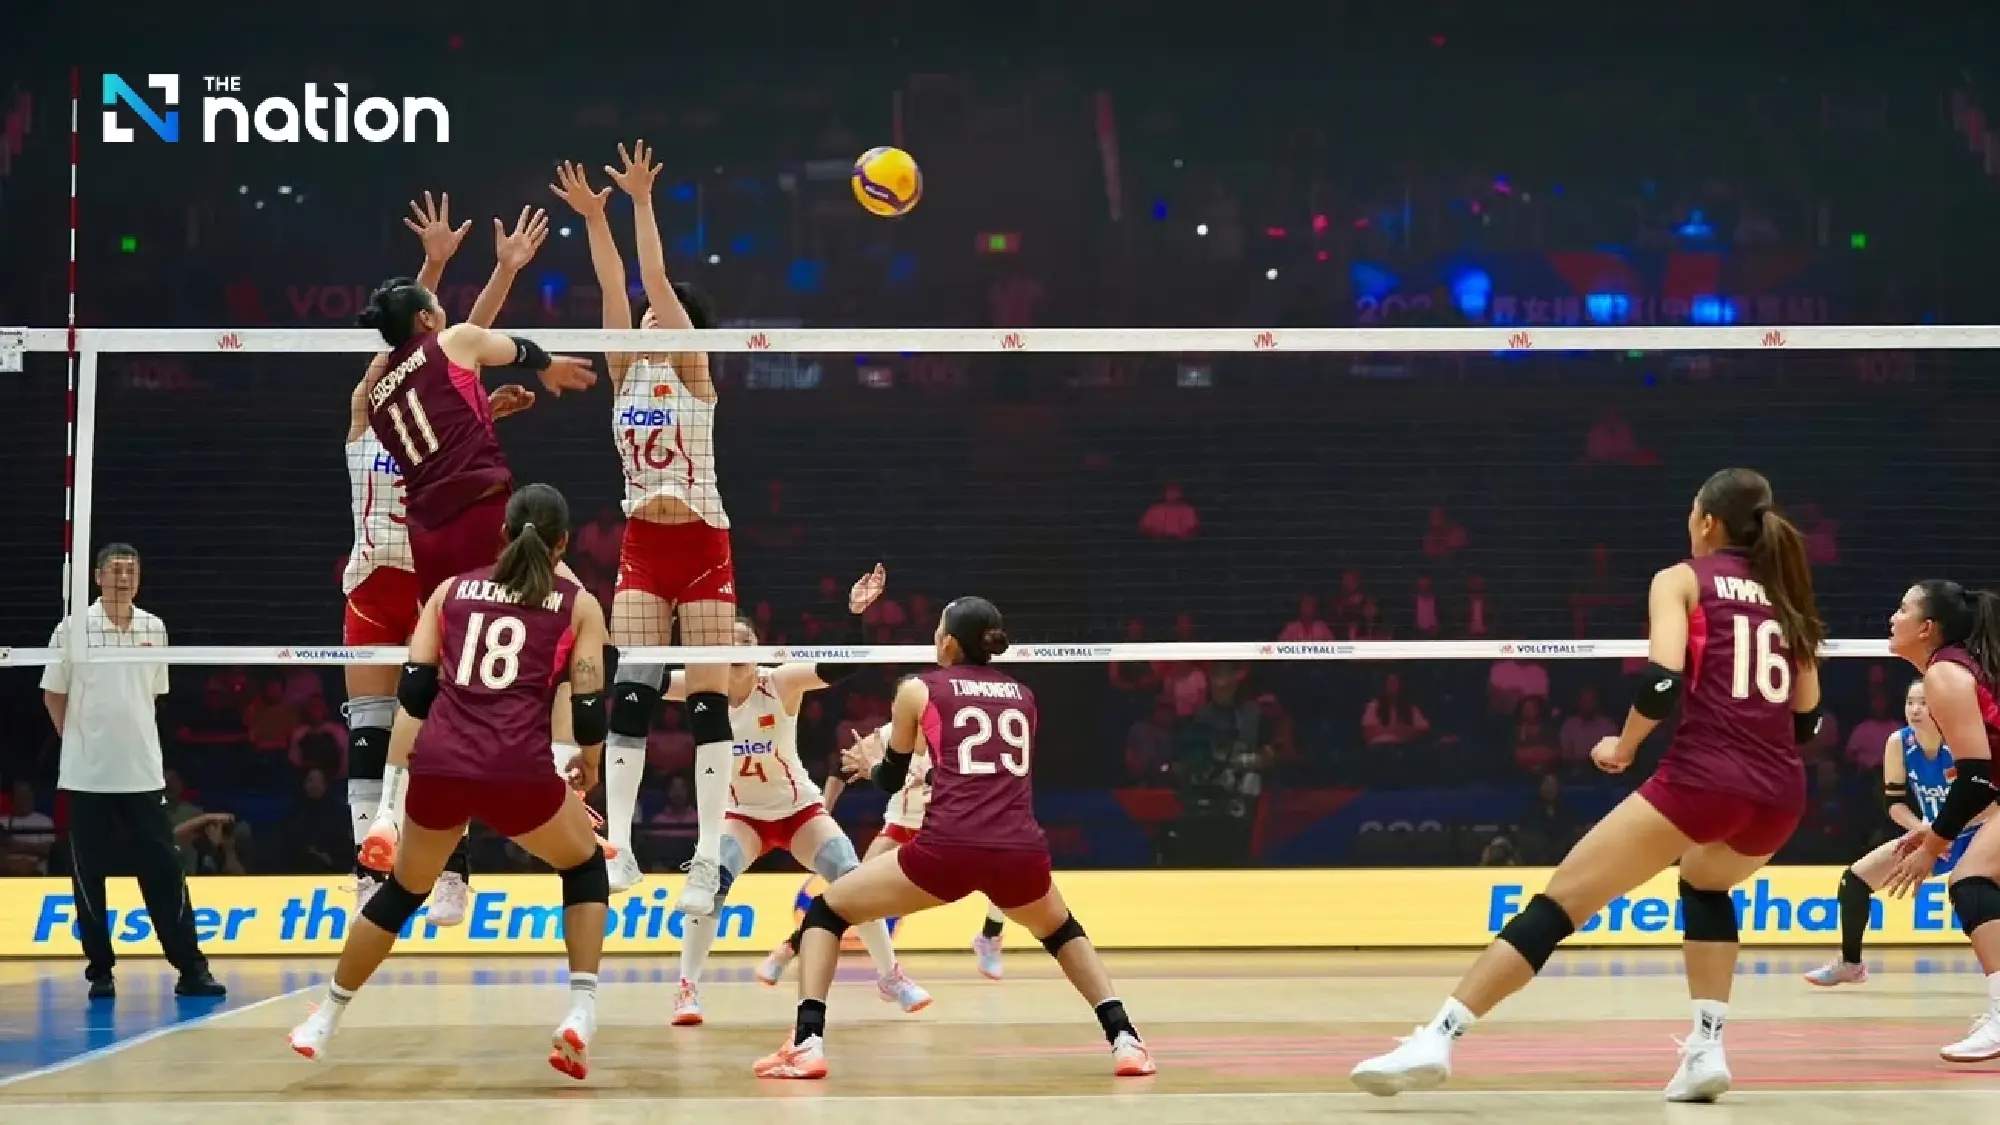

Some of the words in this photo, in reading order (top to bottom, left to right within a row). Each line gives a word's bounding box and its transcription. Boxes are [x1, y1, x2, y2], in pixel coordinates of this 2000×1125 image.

[388, 388, 438, 466] 11
[625, 428, 675, 470] 16
[295, 650, 355, 659] VOLLEYBALL
[455, 612, 527, 690] 18
[790, 650, 850, 658] VOLLEYBALL
[1033, 648, 1092, 657] VOLLEYBALL
[1276, 645, 1335, 655] VOLLEYBALL
[1517, 644, 1576, 654] VOLLEYBALL
[1732, 614, 1790, 703] 16
[732, 740, 772, 756] aier
[953, 706, 1029, 777] 29
[740, 756, 768, 783] 4
[33, 894, 257, 942] Fser
[280, 888, 438, 940] thn
[468, 887, 755, 940] Emtin
